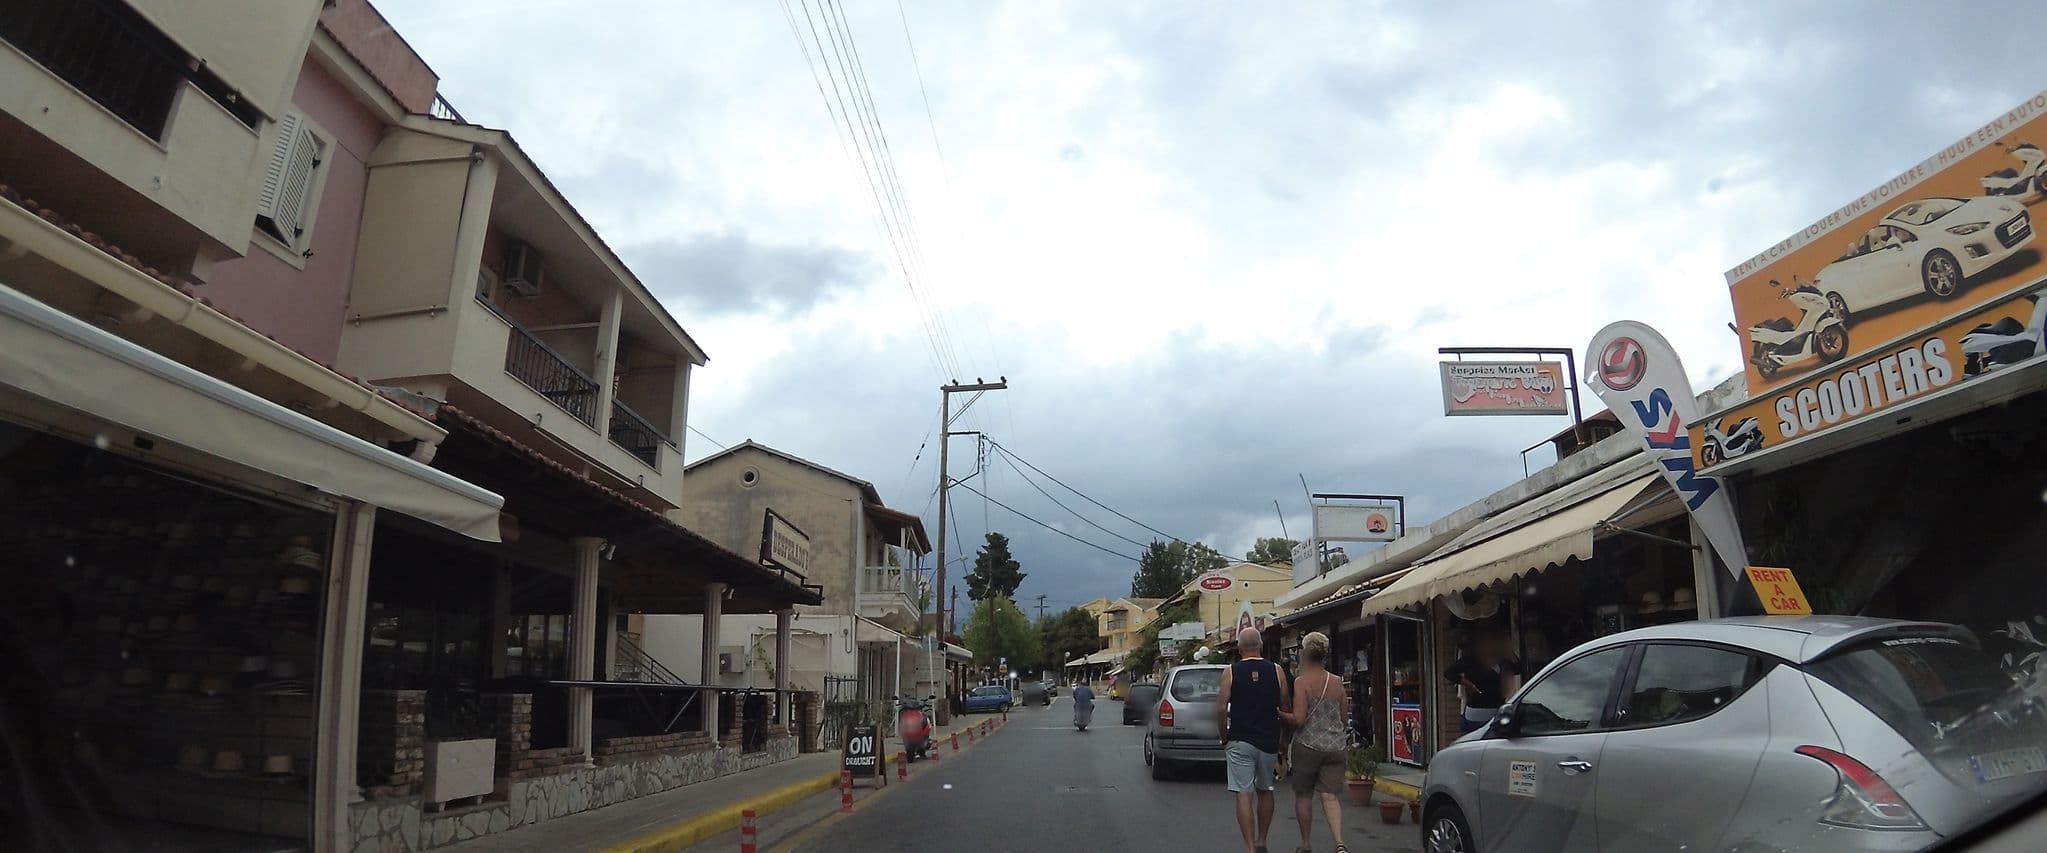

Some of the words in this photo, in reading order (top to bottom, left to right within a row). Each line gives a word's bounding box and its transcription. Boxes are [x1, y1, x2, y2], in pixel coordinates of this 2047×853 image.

[1733, 262, 1758, 278] RENT
[1760, 254, 1768, 265] A
[1770, 238, 1793, 257] CAR
[1806, 212, 1841, 239] LOUER
[1844, 196, 1868, 217] UNE
[1872, 164, 1925, 200] VOITURE
[1938, 137, 1975, 164] HUUR
[1978, 118, 2004, 142] EEN
[2008, 95, 2046, 124] AUTO
[1498, 366, 1535, 375] Market
[1775, 336, 1952, 438] SCOOTERS
[1751, 569, 1790, 582] RENT
[1773, 583, 1785, 596] A
[1770, 597, 1801, 610] CAR
[849, 736, 873, 755] ON
[845, 756, 876, 766] DRAUGHT
